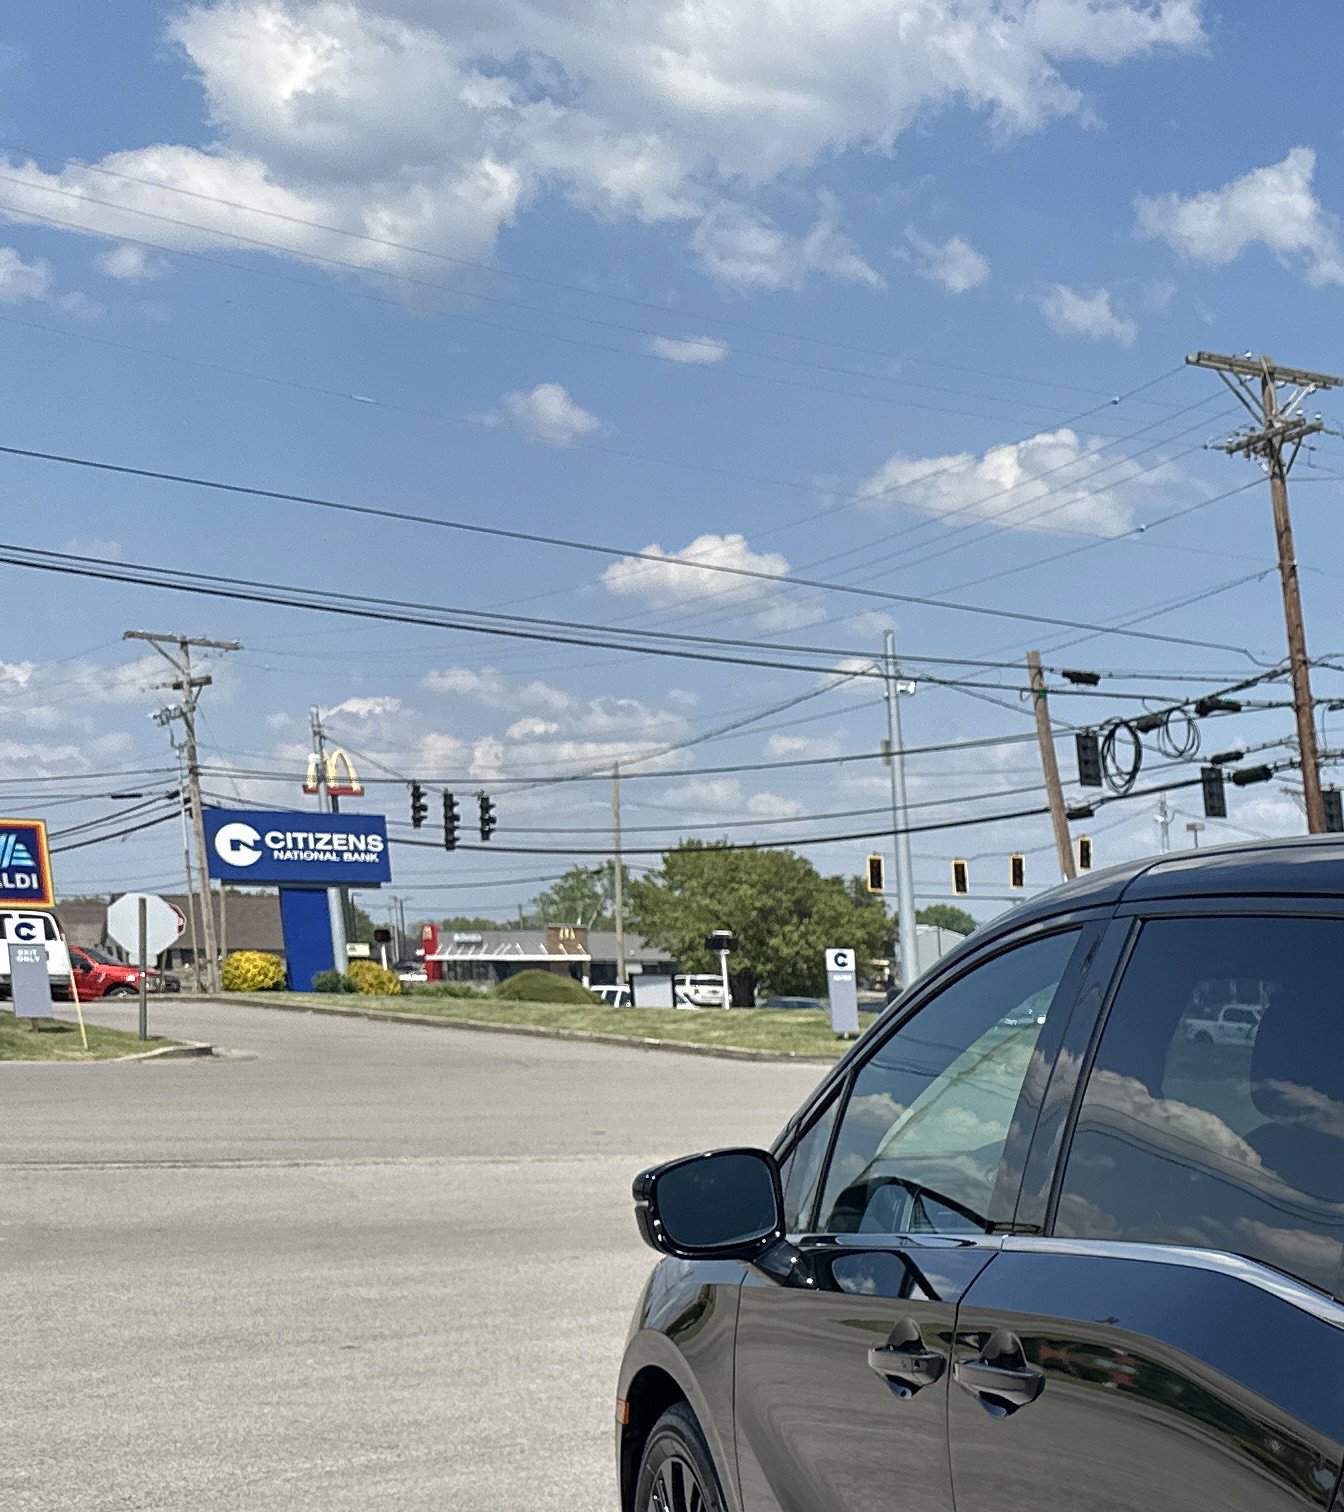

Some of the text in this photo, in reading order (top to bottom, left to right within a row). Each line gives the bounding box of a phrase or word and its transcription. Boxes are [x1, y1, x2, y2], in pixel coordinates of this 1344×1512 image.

[264, 830, 384, 852] CITIZENS
[273, 850, 379, 863] NATIONAL BANK
[0, 872, 38, 890] LDI
